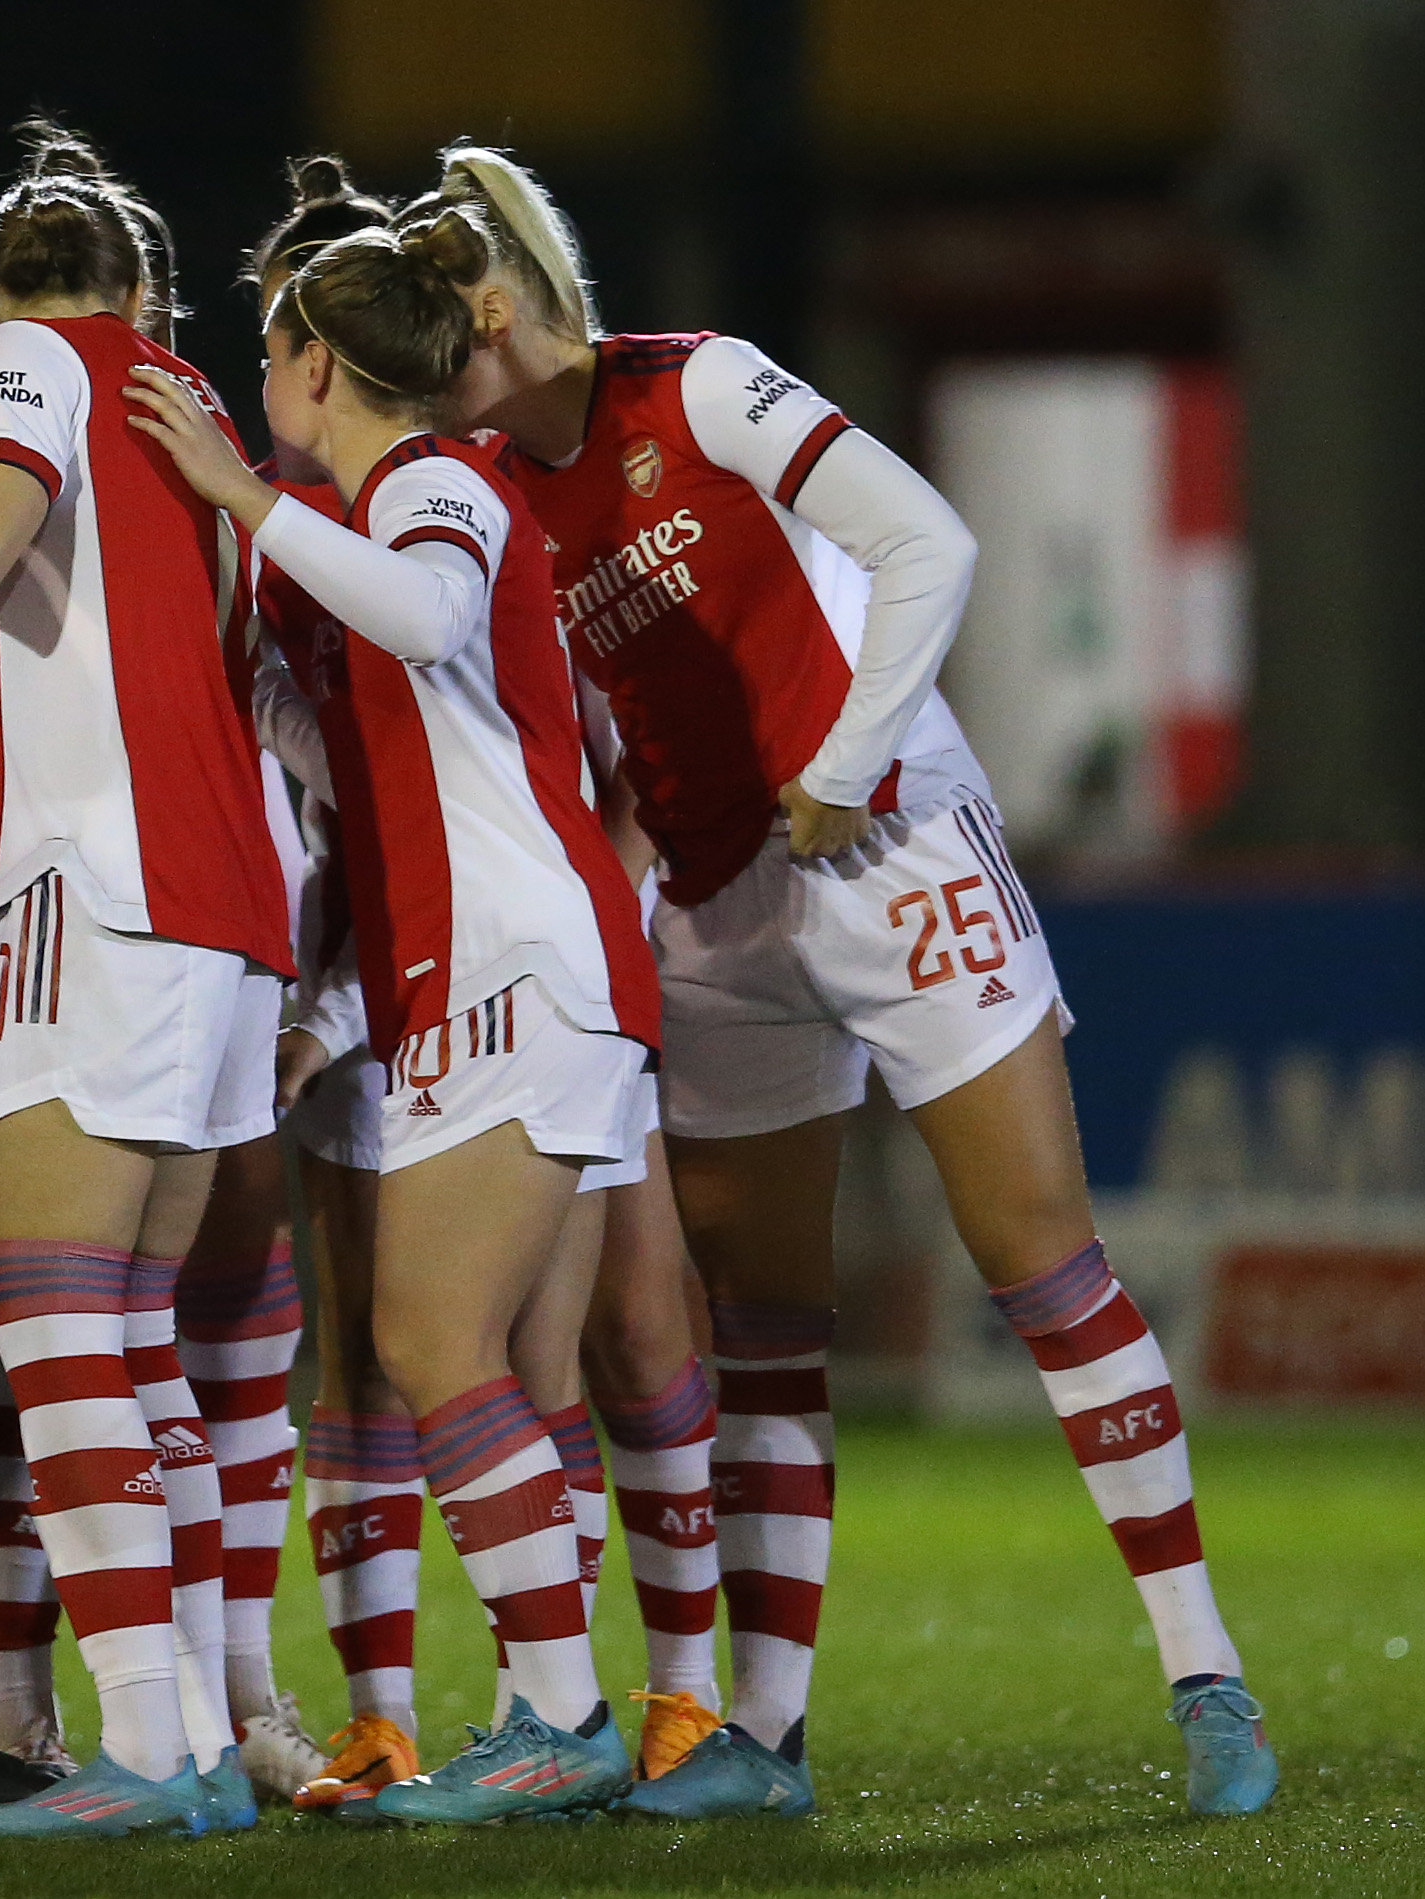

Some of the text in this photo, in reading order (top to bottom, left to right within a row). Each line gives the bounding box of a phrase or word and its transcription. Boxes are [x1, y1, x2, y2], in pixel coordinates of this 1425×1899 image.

[745, 379, 804, 425] RWAN
[426, 498, 473, 519] VISIT
[583, 561, 701, 658] FLY BETTER
[887, 874, 1006, 991] 25
[977, 991, 1016, 1009] adidas
[1099, 1403, 1164, 1446] AFC
[155, 1443, 214, 1460] didas
[321, 1514, 385, 1558] AFC
